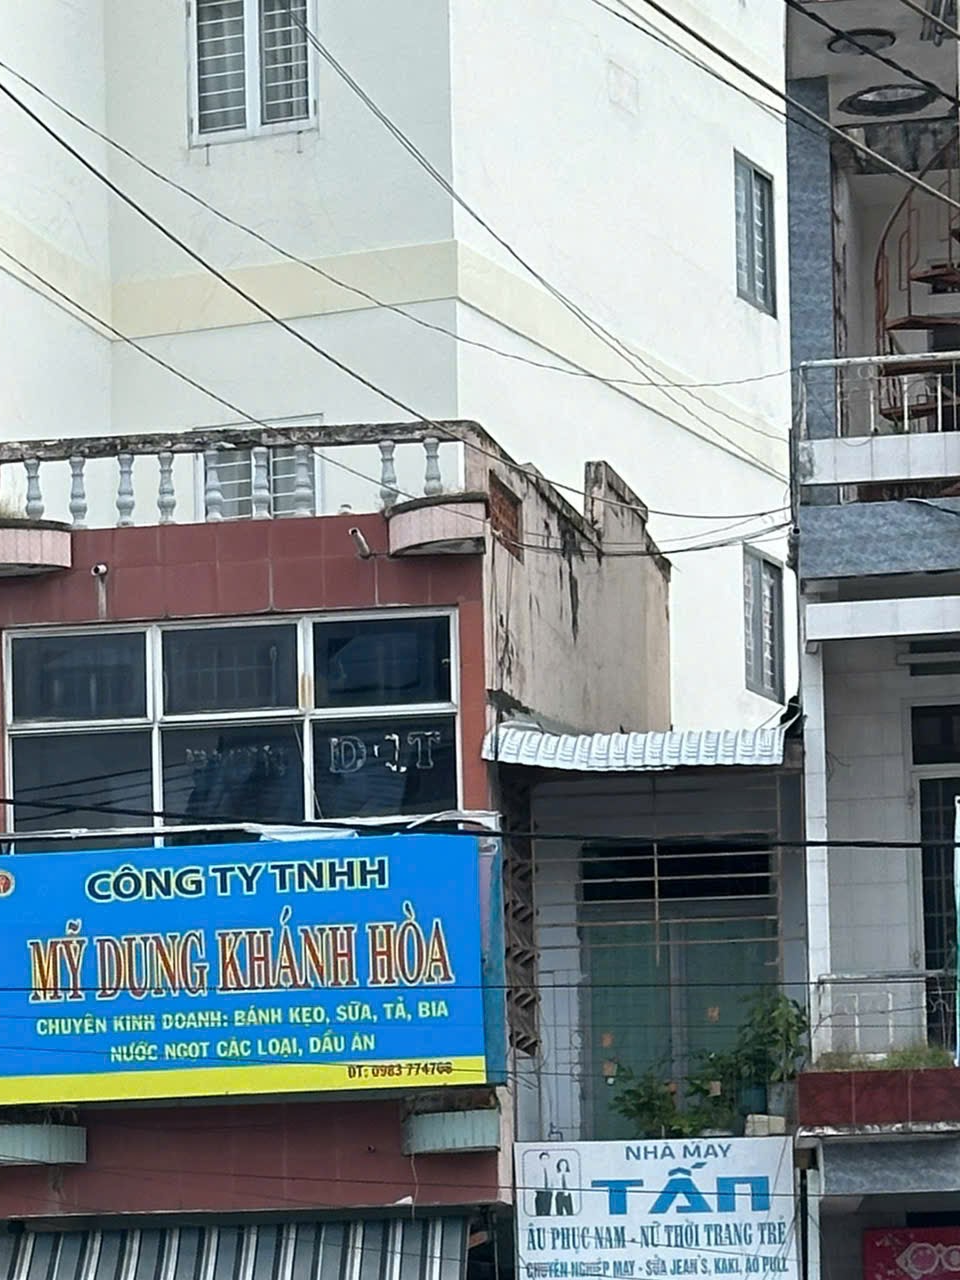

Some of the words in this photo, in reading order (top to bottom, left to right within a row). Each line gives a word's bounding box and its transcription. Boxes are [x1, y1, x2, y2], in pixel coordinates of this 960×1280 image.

[85, 864, 203, 902] CÔNG
[210, 863, 266, 898] TY
[268, 856, 390, 893] TNHH
[27, 918, 88, 1004] MỸ
[94, 928, 209, 1002] DUNG
[215, 904, 357, 994] KHÁNH
[366, 900, 456, 987] HÒA
[36, 1013, 107, 1035] CHUYÊN
[112, 1013, 156, 1032] KINH
[162, 1010, 228, 1030] DOANH:
[234, 1005, 282, 1026] BÁNH
[289, 1006, 330, 1027] KẸO,
[418, 1000, 449, 1018] BIA
[591, 1162, 770, 1215] TẤN
[594, 1225, 626, 1250] NAM
[704, 1222, 752, 1247] TRANG
[613, 1260, 636, 1278] MAY
